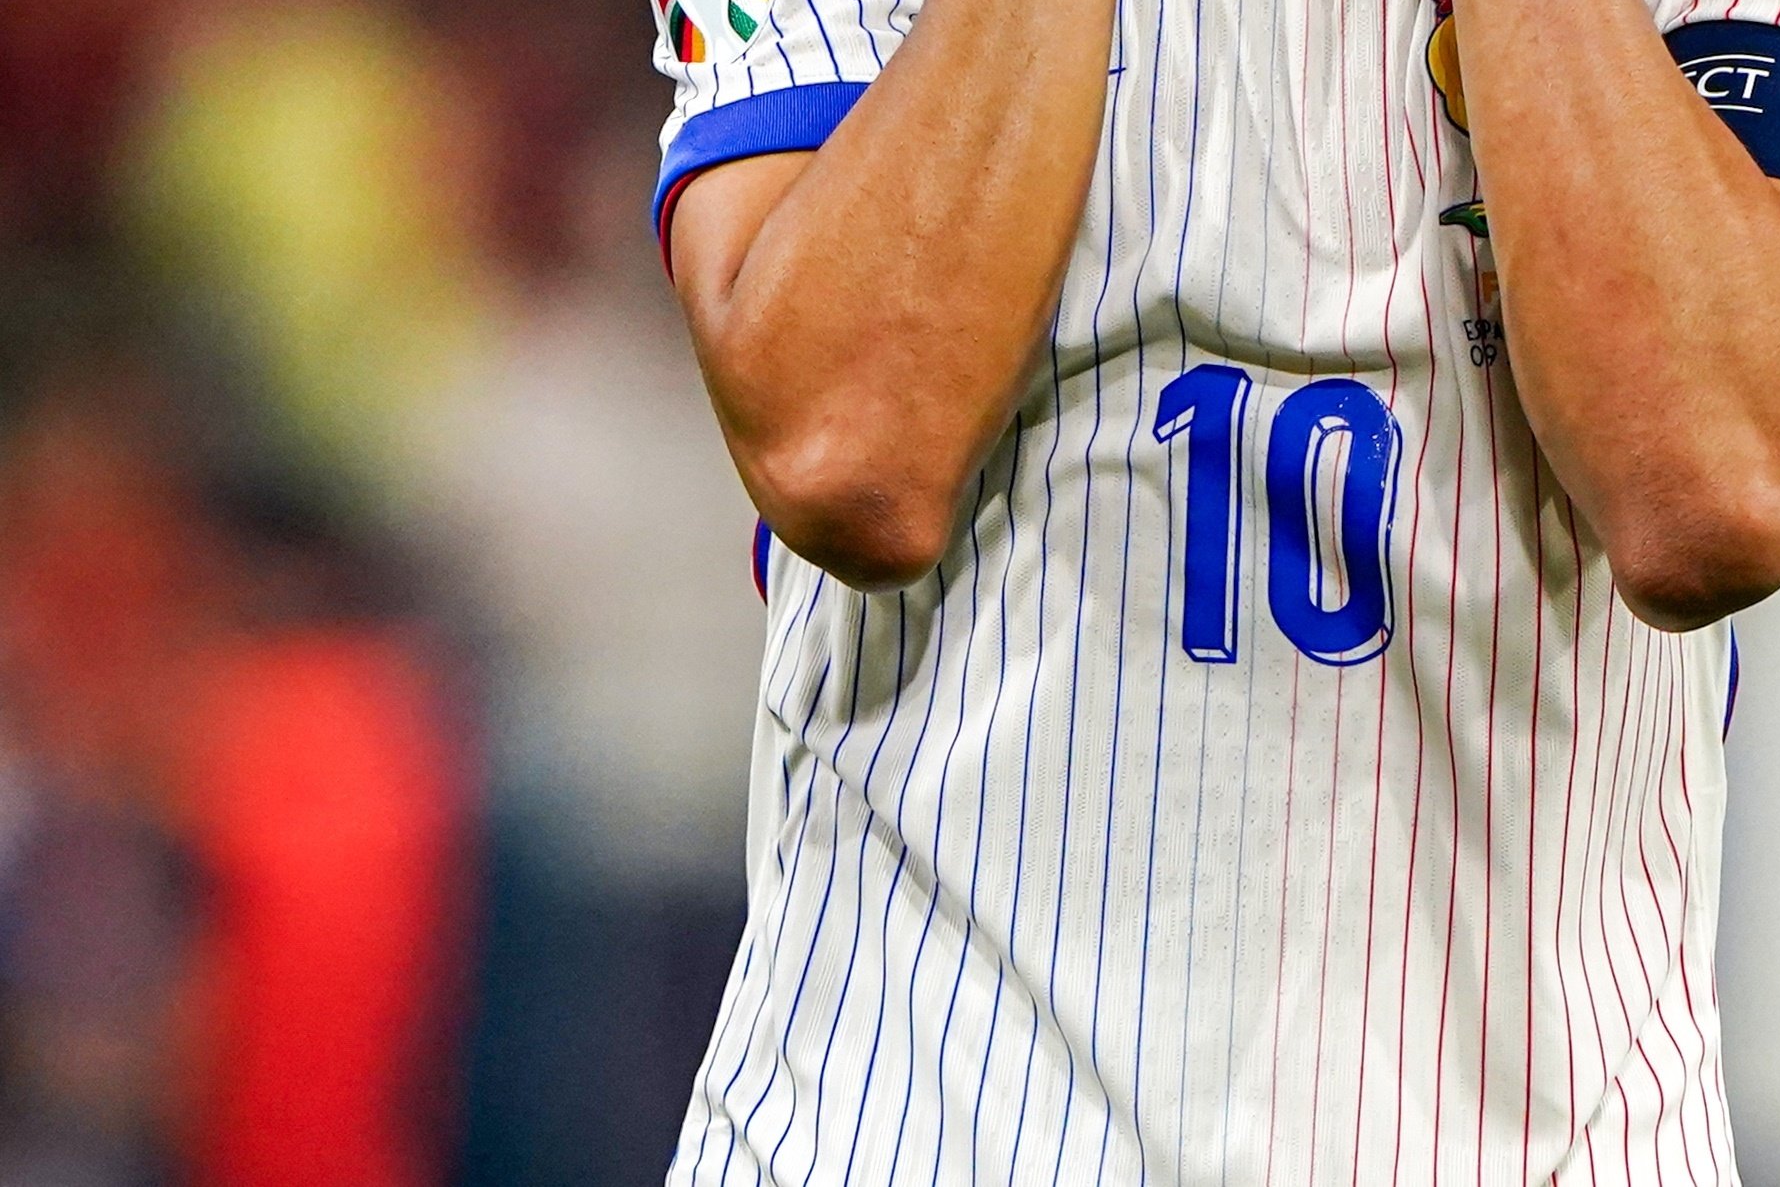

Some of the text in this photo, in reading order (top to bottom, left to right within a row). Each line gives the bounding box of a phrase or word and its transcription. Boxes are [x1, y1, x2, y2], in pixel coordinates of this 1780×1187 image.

[1684, 66, 1770, 99] CT
[1470, 344, 1497, 366] 09
[1152, 363, 1403, 667] 10
